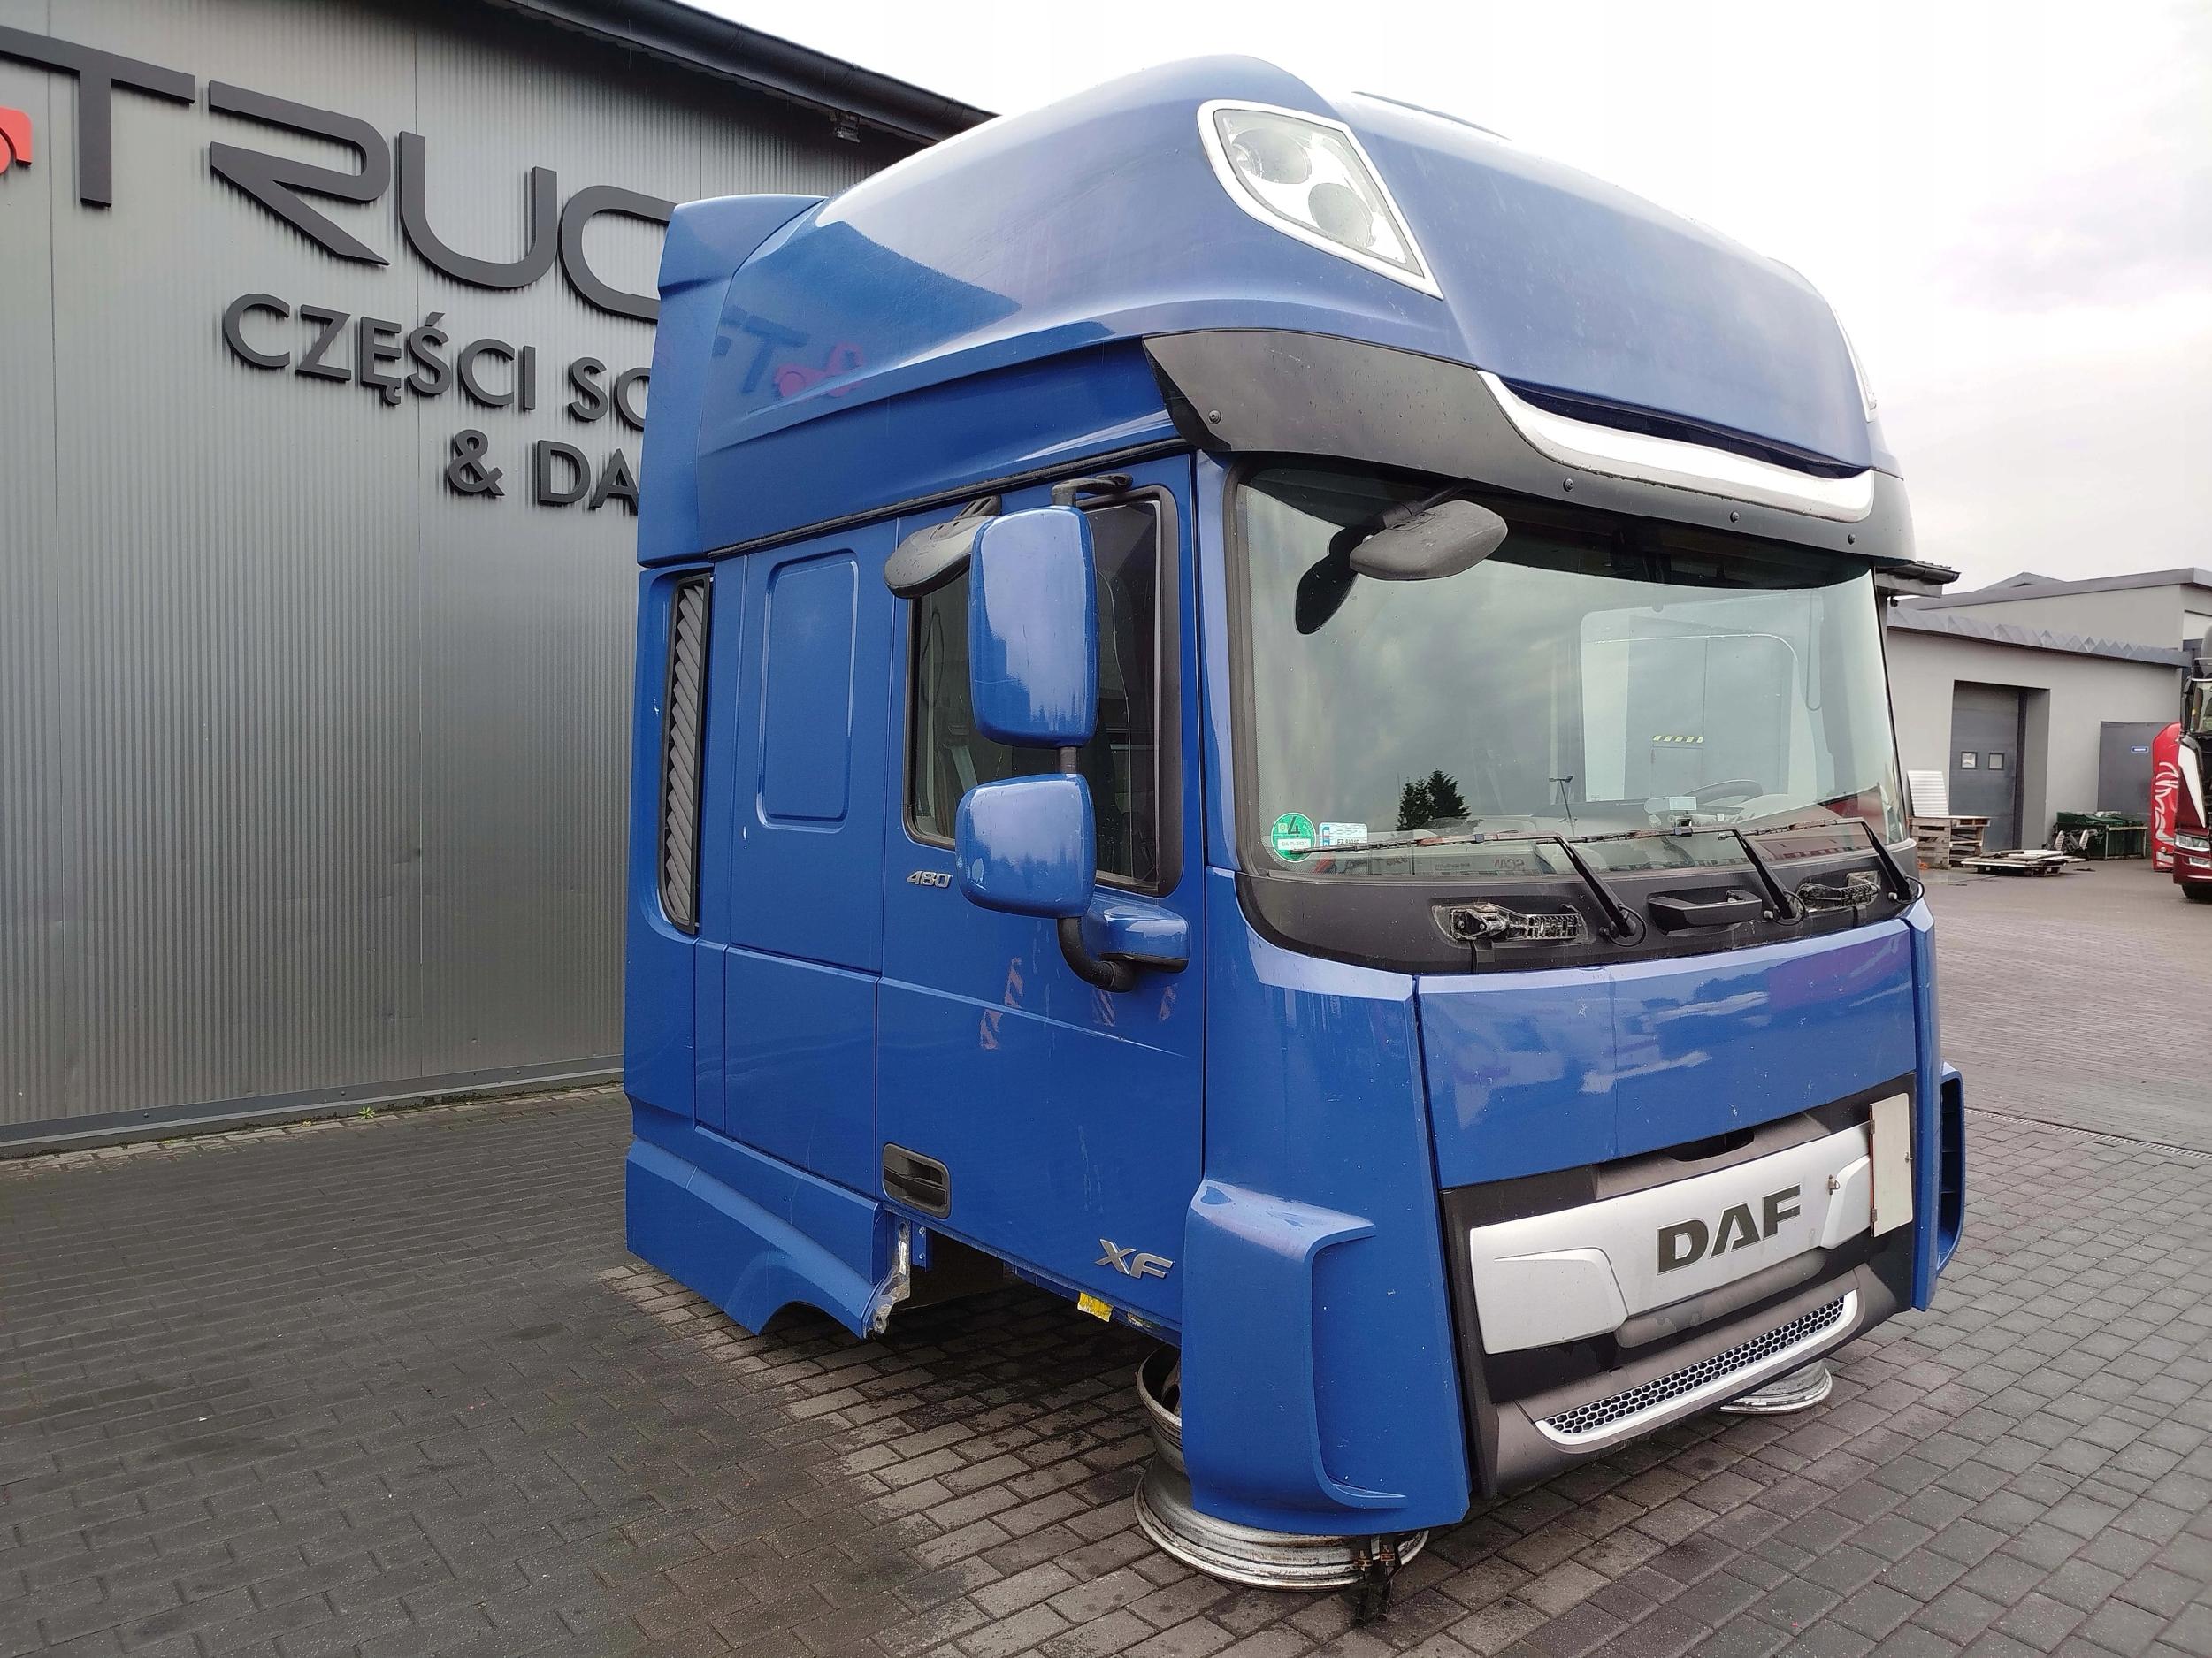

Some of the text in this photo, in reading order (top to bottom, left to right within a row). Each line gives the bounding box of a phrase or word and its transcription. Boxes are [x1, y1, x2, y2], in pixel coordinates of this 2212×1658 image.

[223, 294, 536, 410] CZĘŚCI
[447, 429, 505, 497] &
[1288, 816, 1301, 834] 4
[906, 870, 953, 888] 480
[1656, 1182, 1801, 1276] DAF
[1094, 1238, 1174, 1279] XF
